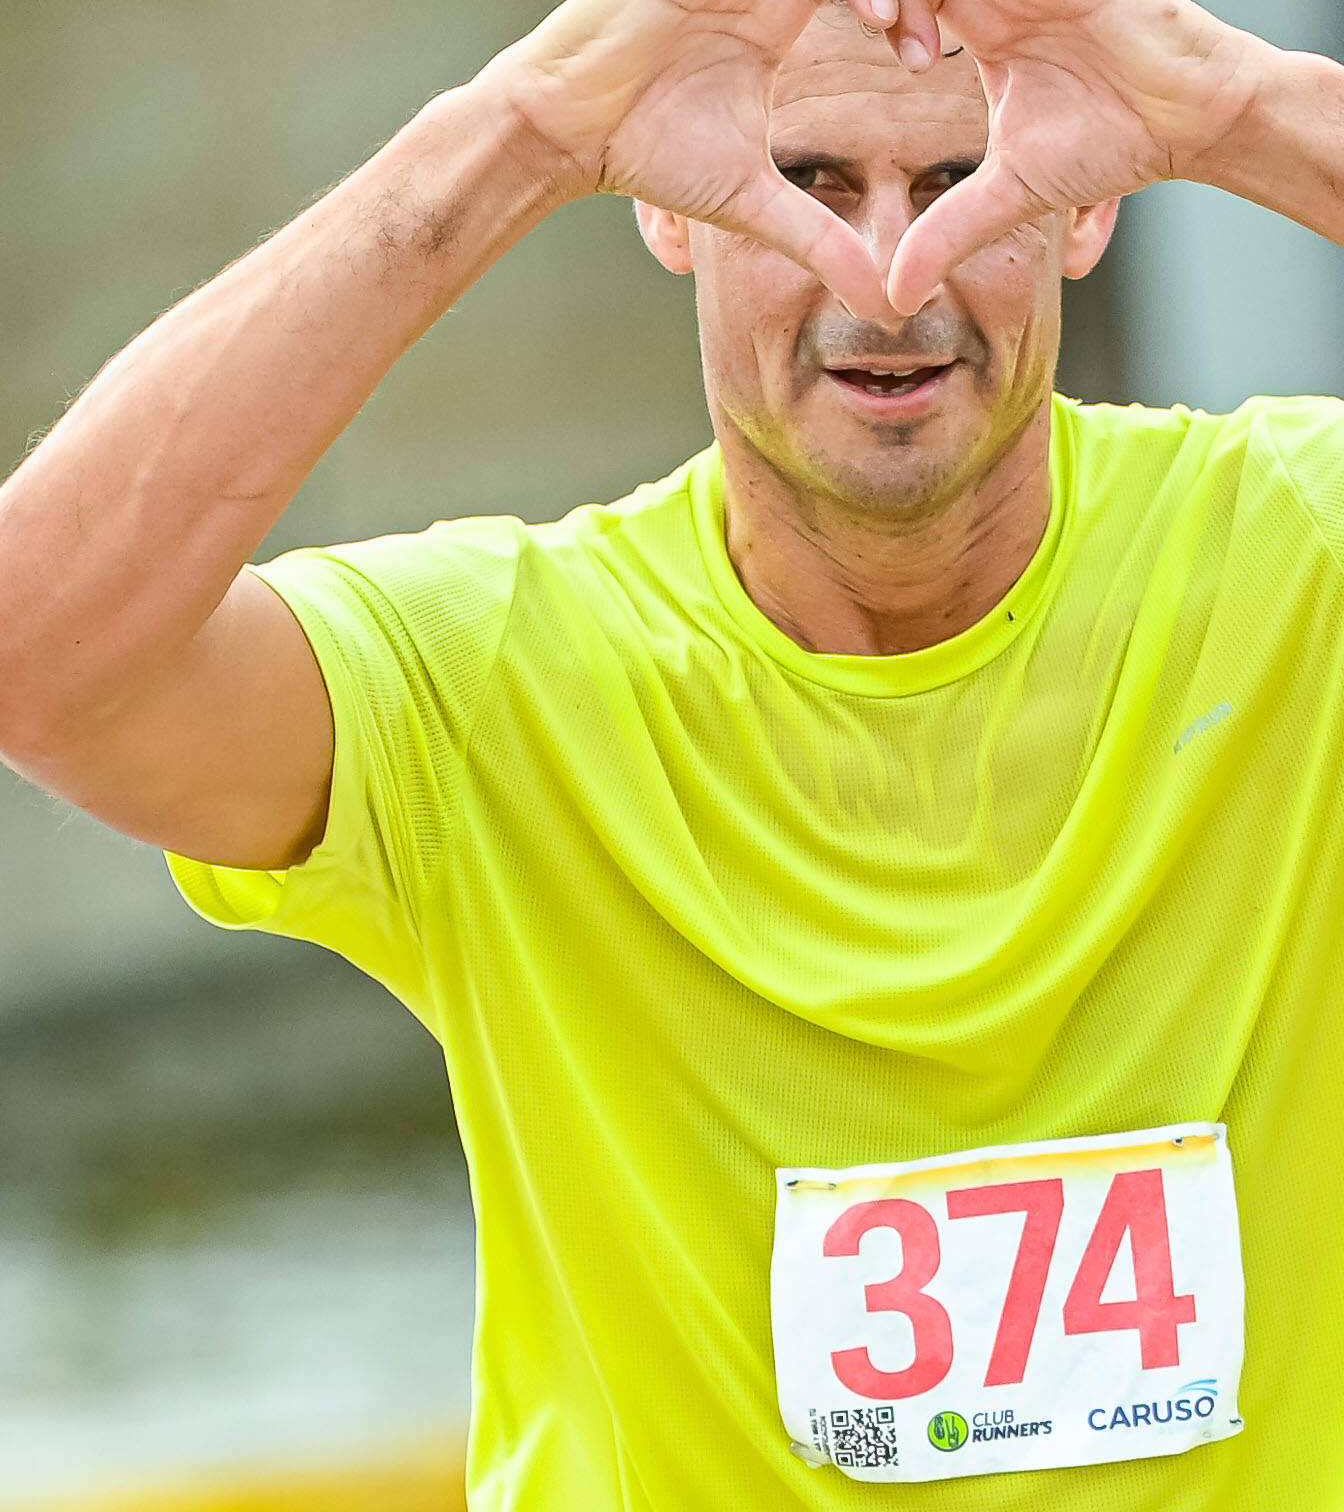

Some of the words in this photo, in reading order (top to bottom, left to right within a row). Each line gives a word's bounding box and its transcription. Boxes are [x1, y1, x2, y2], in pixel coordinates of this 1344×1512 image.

[822, 1168, 1197, 1401] 374
[972, 1409, 1014, 1427] CLUB
[1087, 1396, 1215, 1431] CARUSO
[972, 1420, 1052, 1443] RUNNER'S
